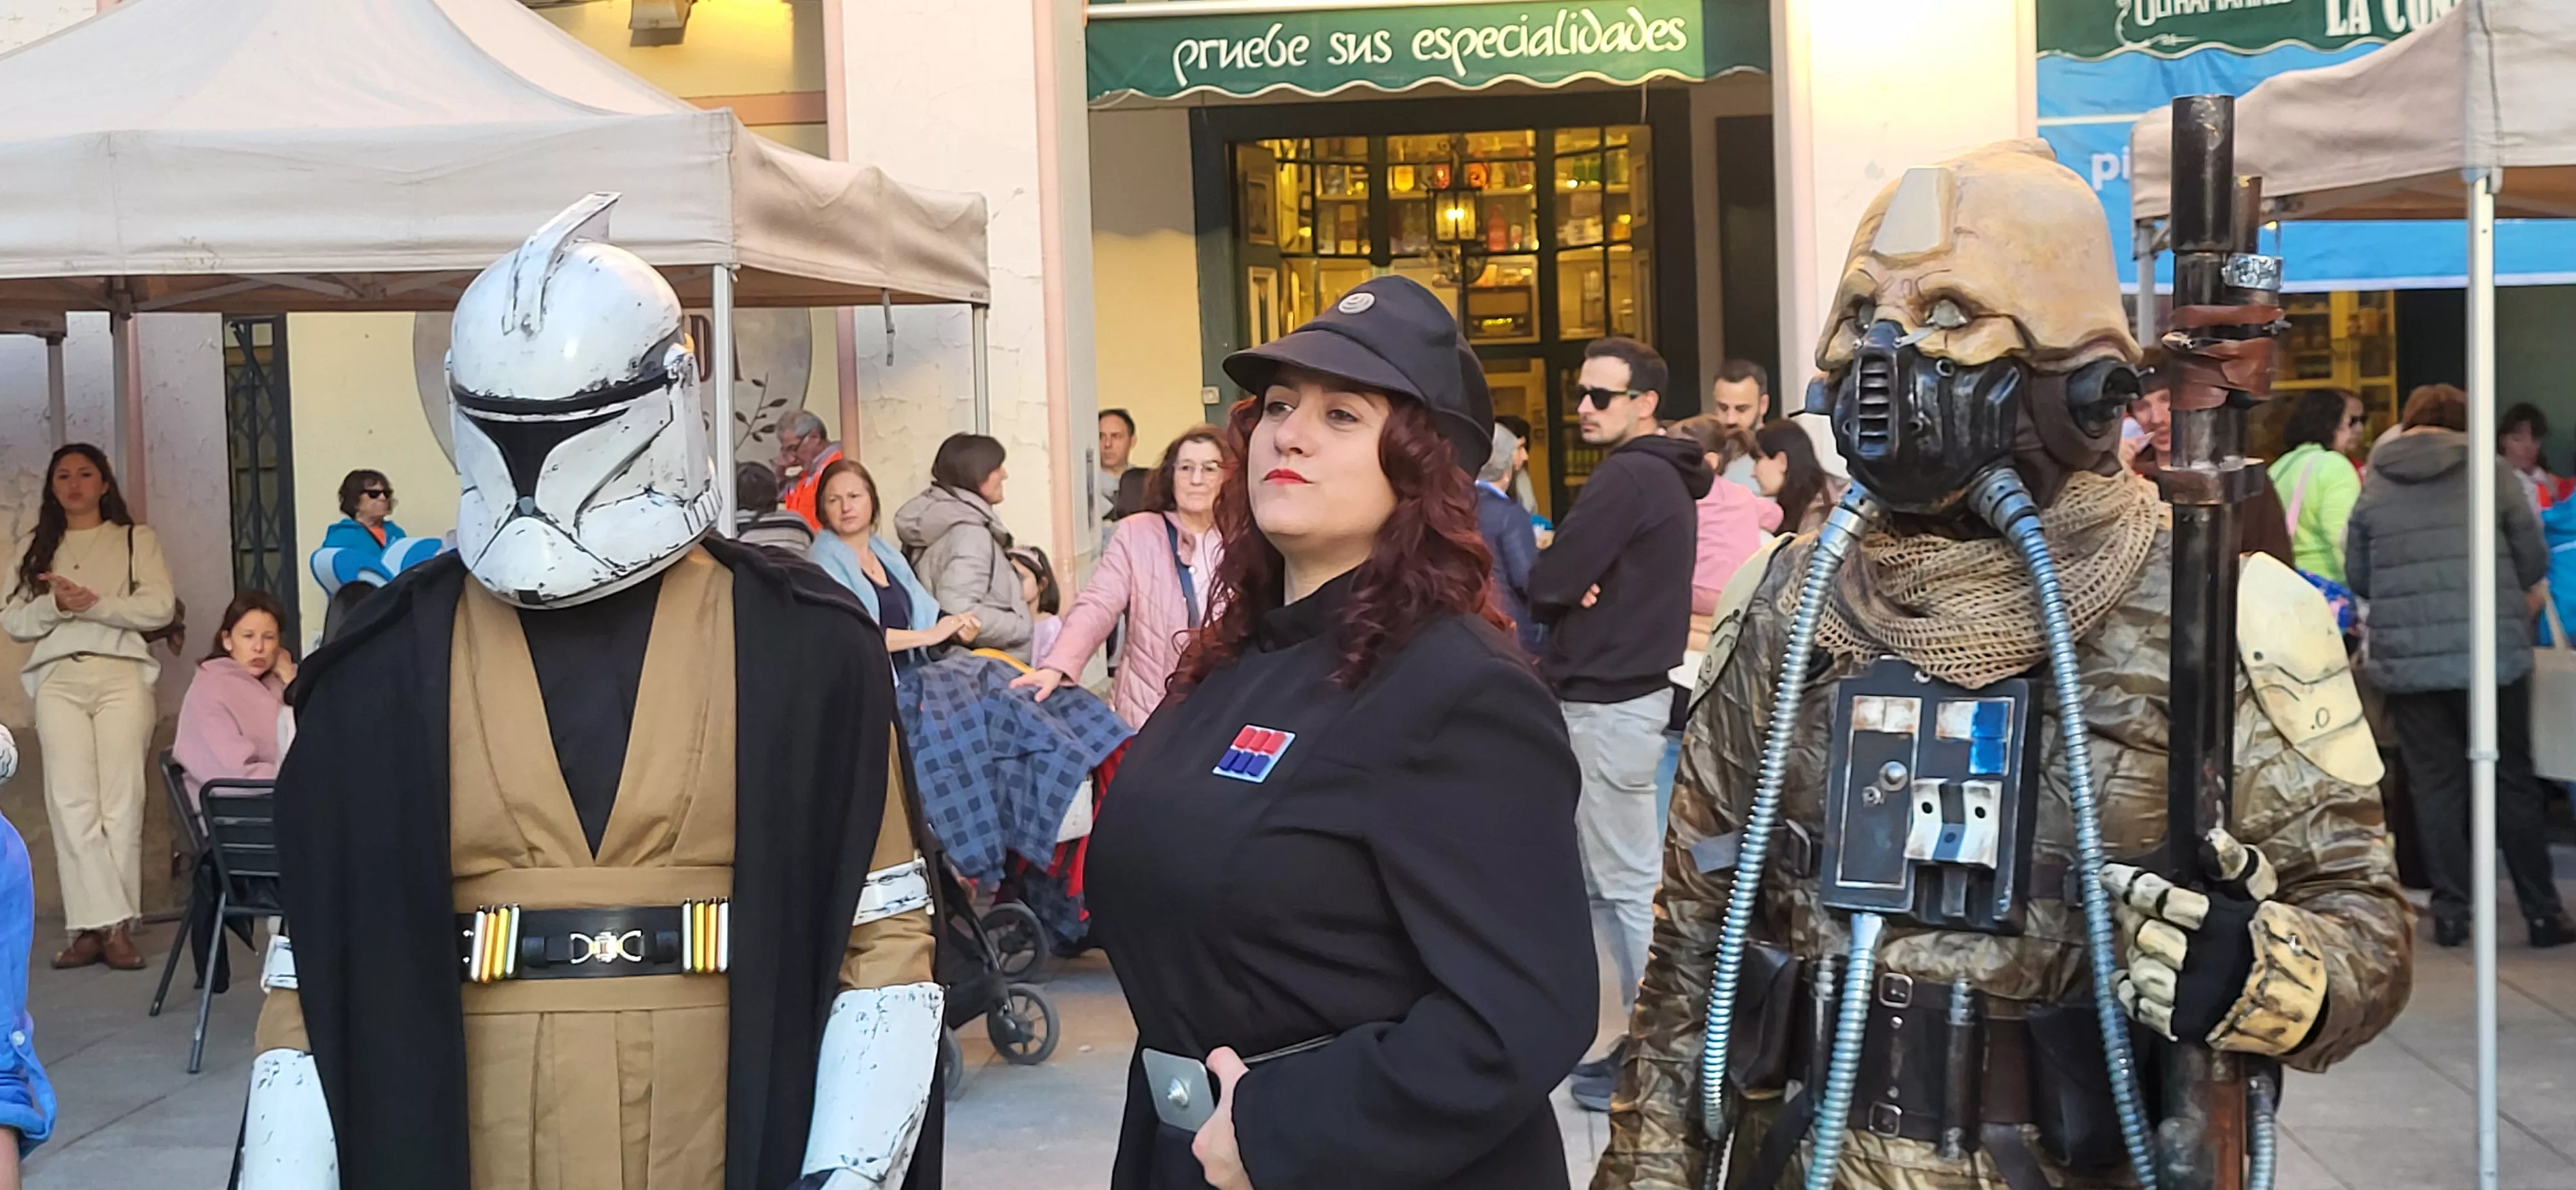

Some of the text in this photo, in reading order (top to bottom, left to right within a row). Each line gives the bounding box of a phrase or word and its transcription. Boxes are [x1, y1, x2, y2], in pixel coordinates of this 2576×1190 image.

[1172, 6, 1687, 88] pruebe sus especialidades
[2325, 0, 2372, 36] LA
